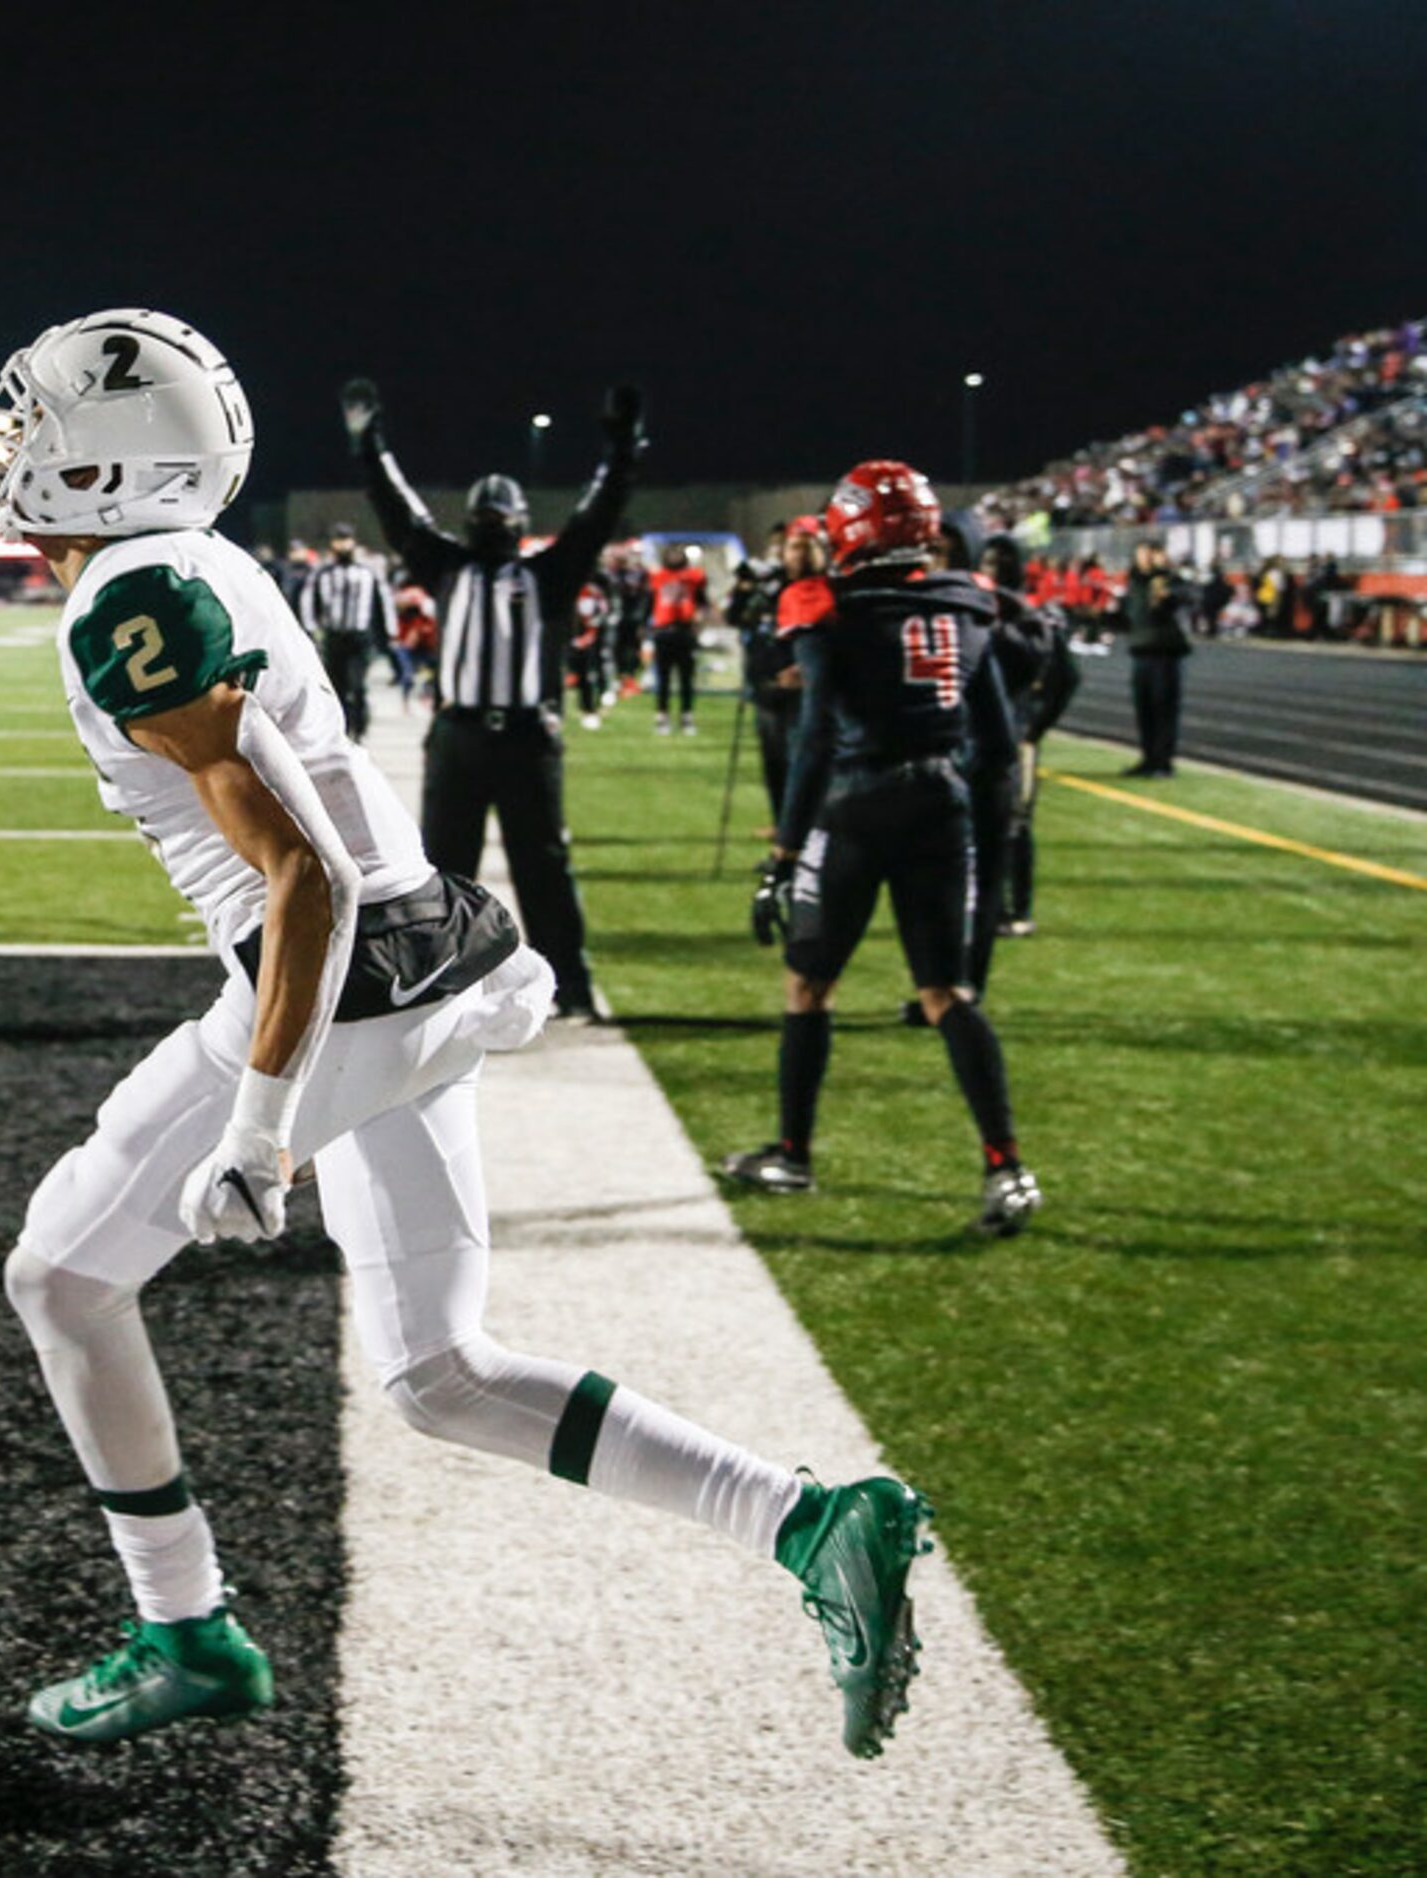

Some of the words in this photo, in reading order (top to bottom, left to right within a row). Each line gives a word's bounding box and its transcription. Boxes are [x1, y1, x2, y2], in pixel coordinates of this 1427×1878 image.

[102, 335, 141, 391] 2
[112, 614, 179, 693] 2
[901, 613, 961, 709] 4
